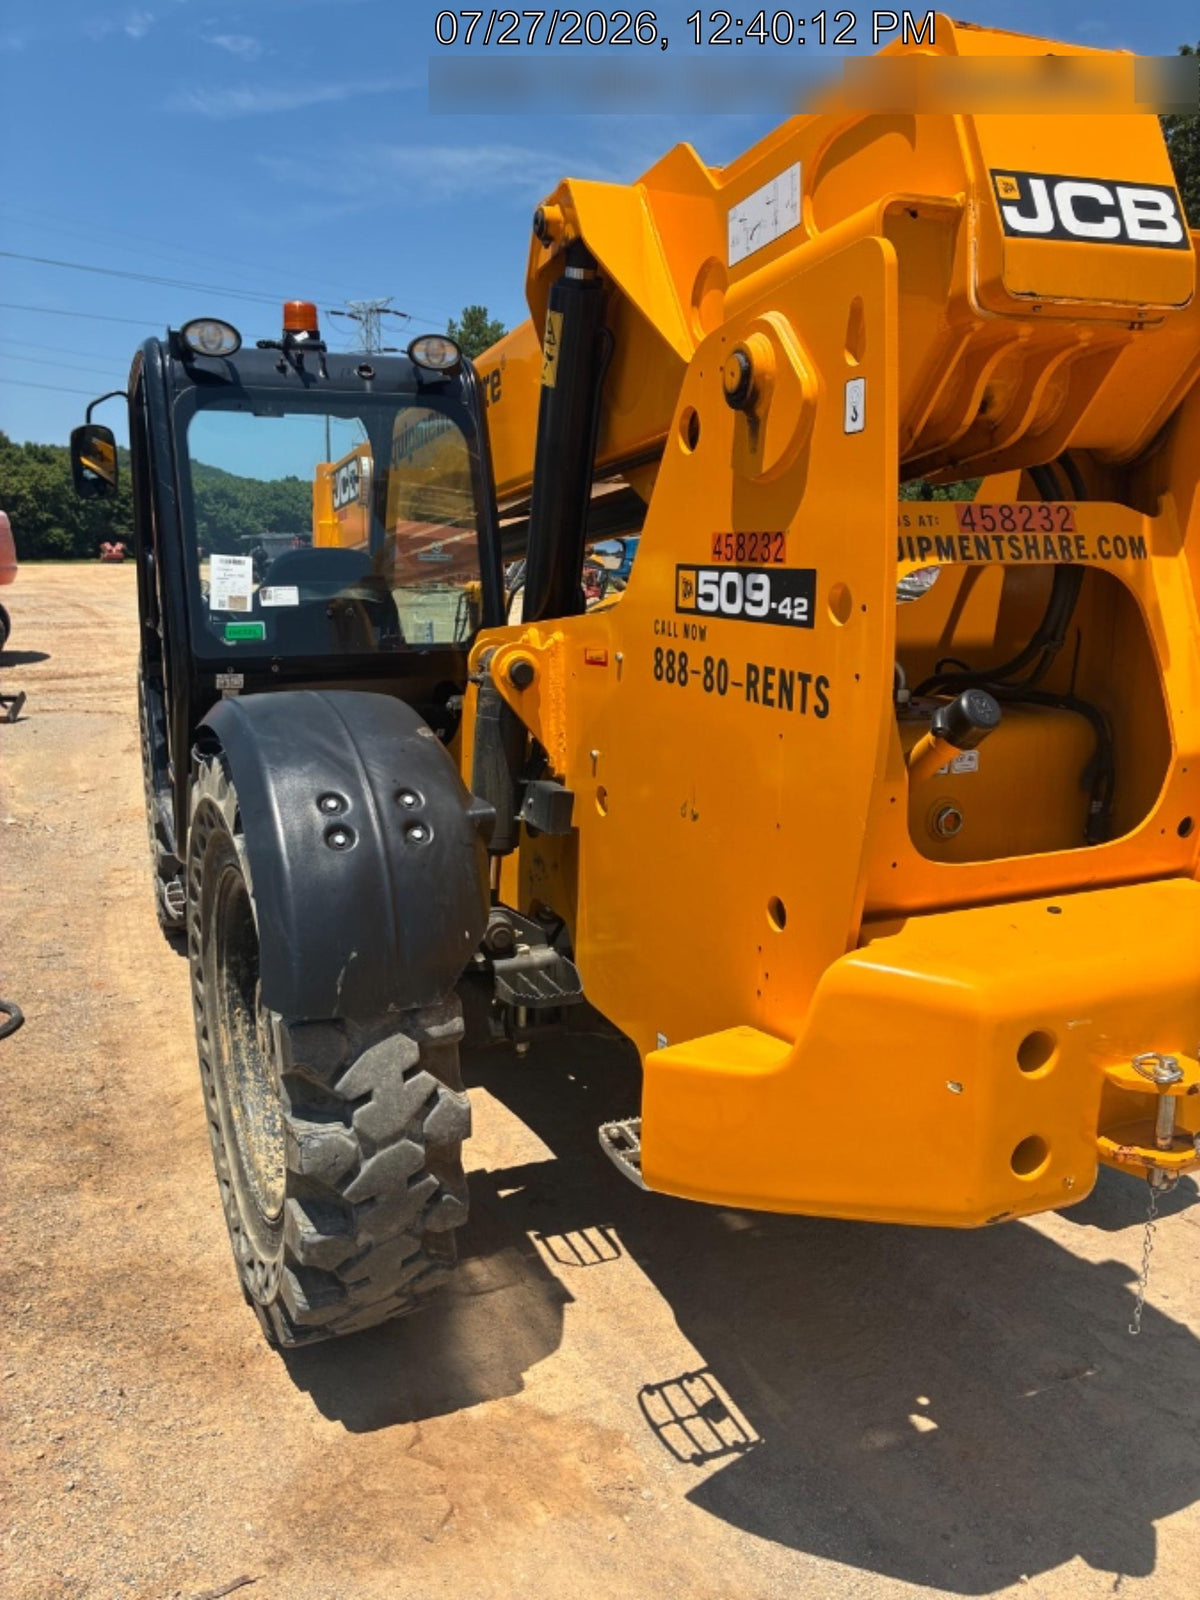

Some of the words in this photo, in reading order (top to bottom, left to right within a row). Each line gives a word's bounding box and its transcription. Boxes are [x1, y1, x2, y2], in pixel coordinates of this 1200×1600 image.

[1002, 178, 1184, 244] JCB
[960, 504, 1075, 533] 458232
[712, 531, 785, 562] 458232
[697, 570, 809, 621] 509-42
[653, 618, 679, 639] CALL
[683, 623, 708, 642] NOW
[653, 646, 830, 719] 888-80-RENTS
